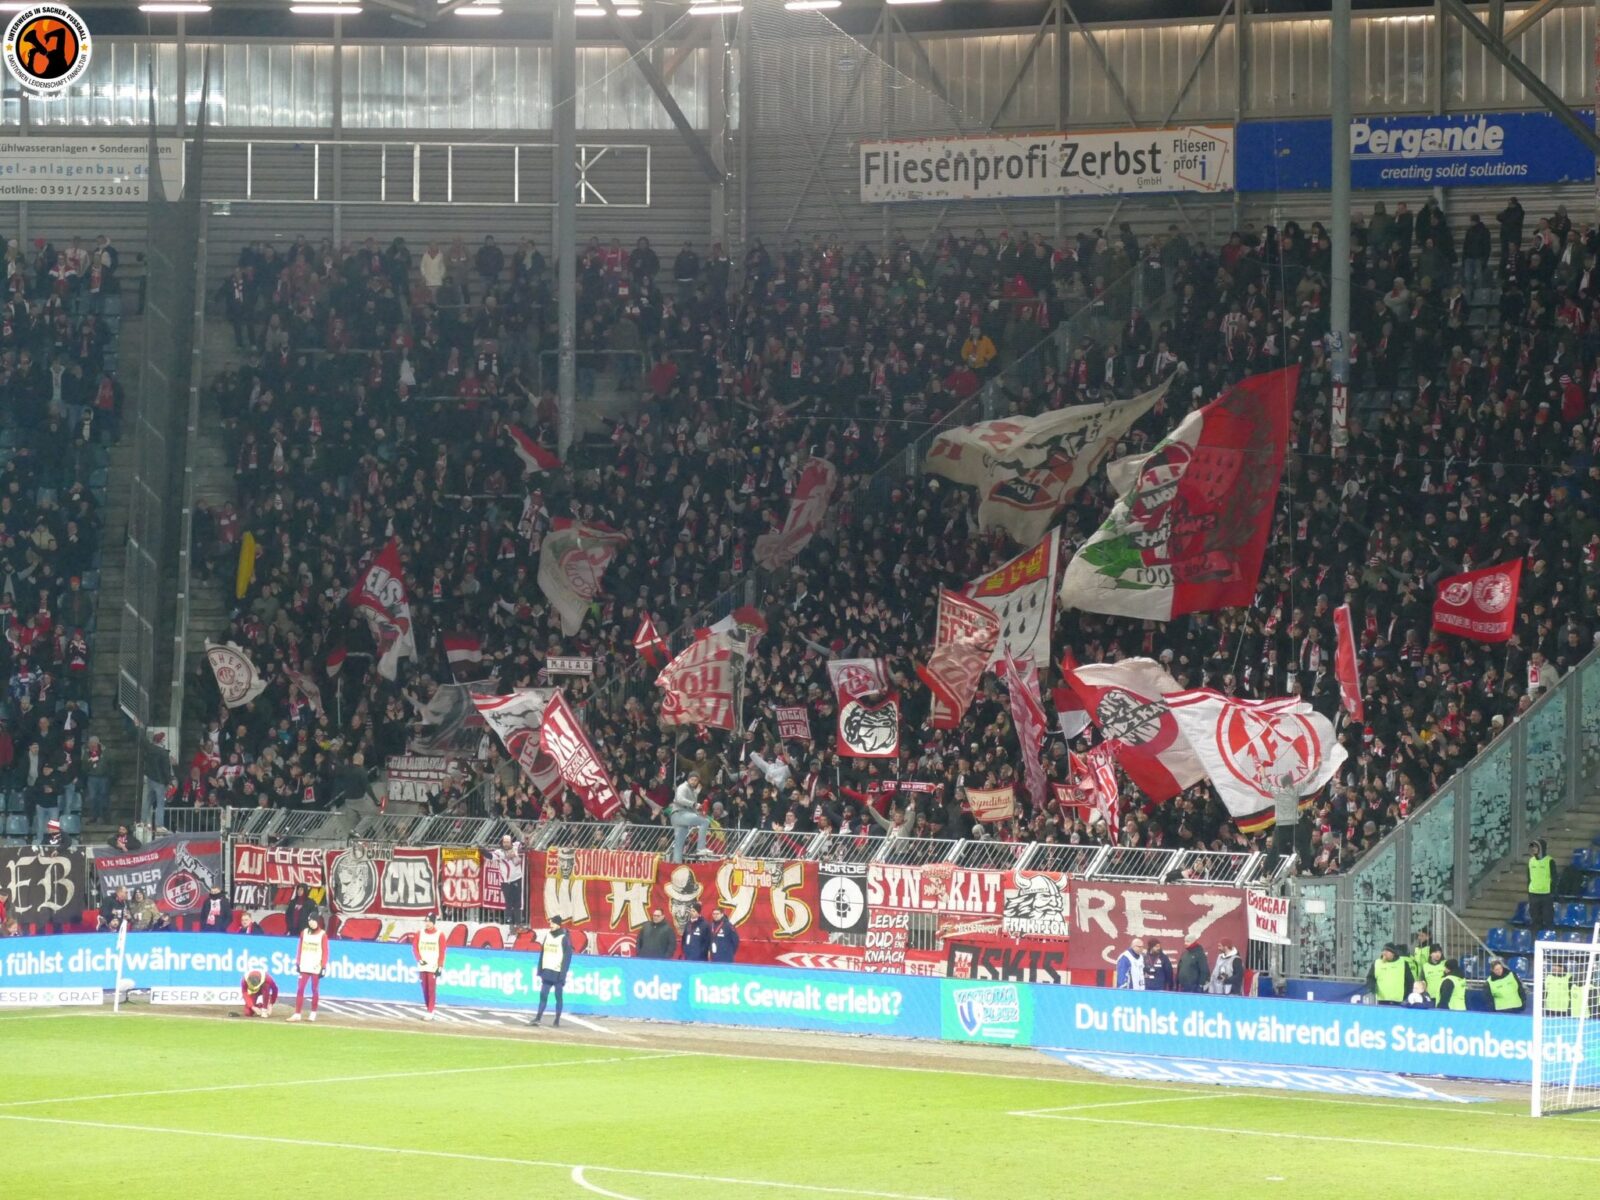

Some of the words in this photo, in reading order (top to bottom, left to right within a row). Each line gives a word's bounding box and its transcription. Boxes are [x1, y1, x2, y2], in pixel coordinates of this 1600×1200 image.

[99, 143, 172, 154] Sonderanlen
[1173, 138, 1215, 153] Fliesen
[1350, 119, 1504, 159] Pergande
[864, 144, 1048, 190] Fliesenprofi
[1060, 140, 1162, 177] Zerbst
[1381, 165, 1432, 181] creating
[1435, 163, 1467, 178] solid
[1470, 162, 1528, 177] solutions
[40, 185, 140, 195] 0391/2523045
[1136, 176, 1162, 186] GmbH
[573, 848, 658, 881] STADIONVERBOT
[818, 863, 867, 874] HORDE
[103, 869, 162, 888] WILDER
[268, 865, 322, 887] JUNGS
[385, 860, 433, 906] CNS
[868, 865, 1001, 913] SYNKAT
[867, 910, 909, 930] LEEVER
[1002, 917, 1069, 936] FRAKTION
[910, 963, 936, 977] SEIT
[7, 951, 63, 976] fühlst
[68, 948, 119, 972] dich
[125, 946, 233, 971] während
[271, 952, 422, 984] Staonbesuchs
[633, 975, 682, 1001] oder
[695, 978, 740, 1004] hast
[744, 982, 821, 1011] Gewalt
[825, 987, 903, 1016] erlebt?
[58, 991, 100, 1002] GRAF
[152, 990, 200, 1002] FESER
[1075, 1003, 1108, 1031] Du
[1112, 1006, 1179, 1036] fühlst
[1182, 1010, 1232, 1040] dich
[1236, 1011, 1341, 1047] während
[1345, 1019, 1386, 1049] des
